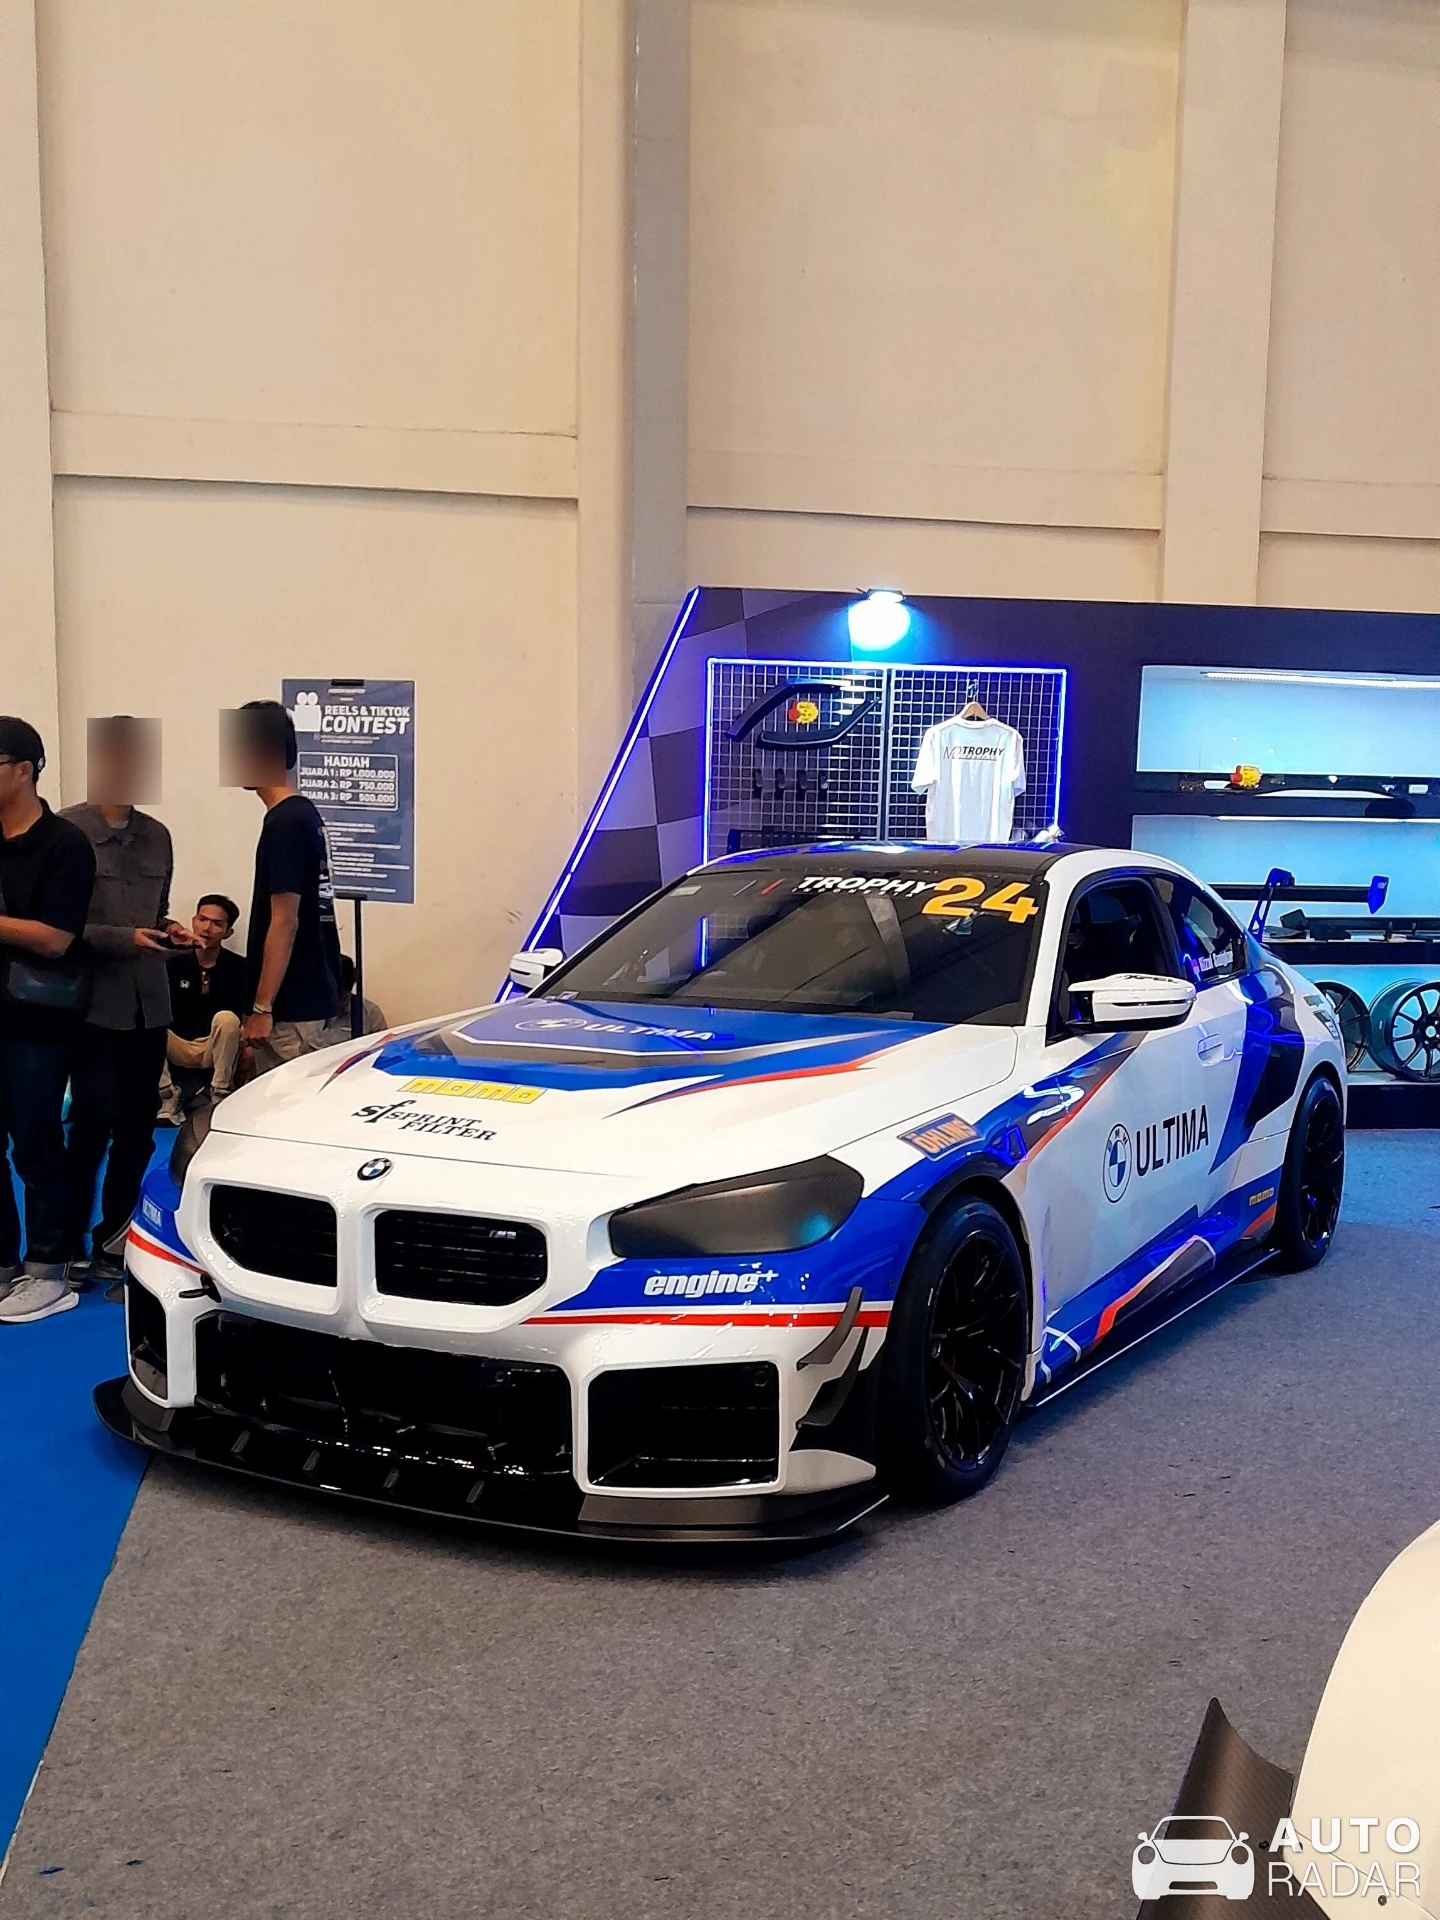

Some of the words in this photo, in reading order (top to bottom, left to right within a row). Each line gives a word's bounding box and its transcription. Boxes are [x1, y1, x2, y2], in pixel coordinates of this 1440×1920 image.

[325, 705, 359, 716] REELS
[360, 706, 369, 716] &
[369, 706, 411, 717] TIKTOK
[322, 715, 411, 735] CONTEST
[323, 755, 370, 768] HADIAH
[339, 768, 352, 777] RP
[339, 780, 352, 789] RP
[339, 791, 352, 801] RP
[797, 876, 938, 895] TROPHY
[922, 877, 1040, 924] 24
[583, 1023, 716, 1041] ULTIMA
[385, 1111, 483, 1128] SPRINT
[398, 1121, 497, 1141] FILTER
[1136, 1104, 1209, 1177] ULTIMA
[644, 1269, 779, 1298] engine+
